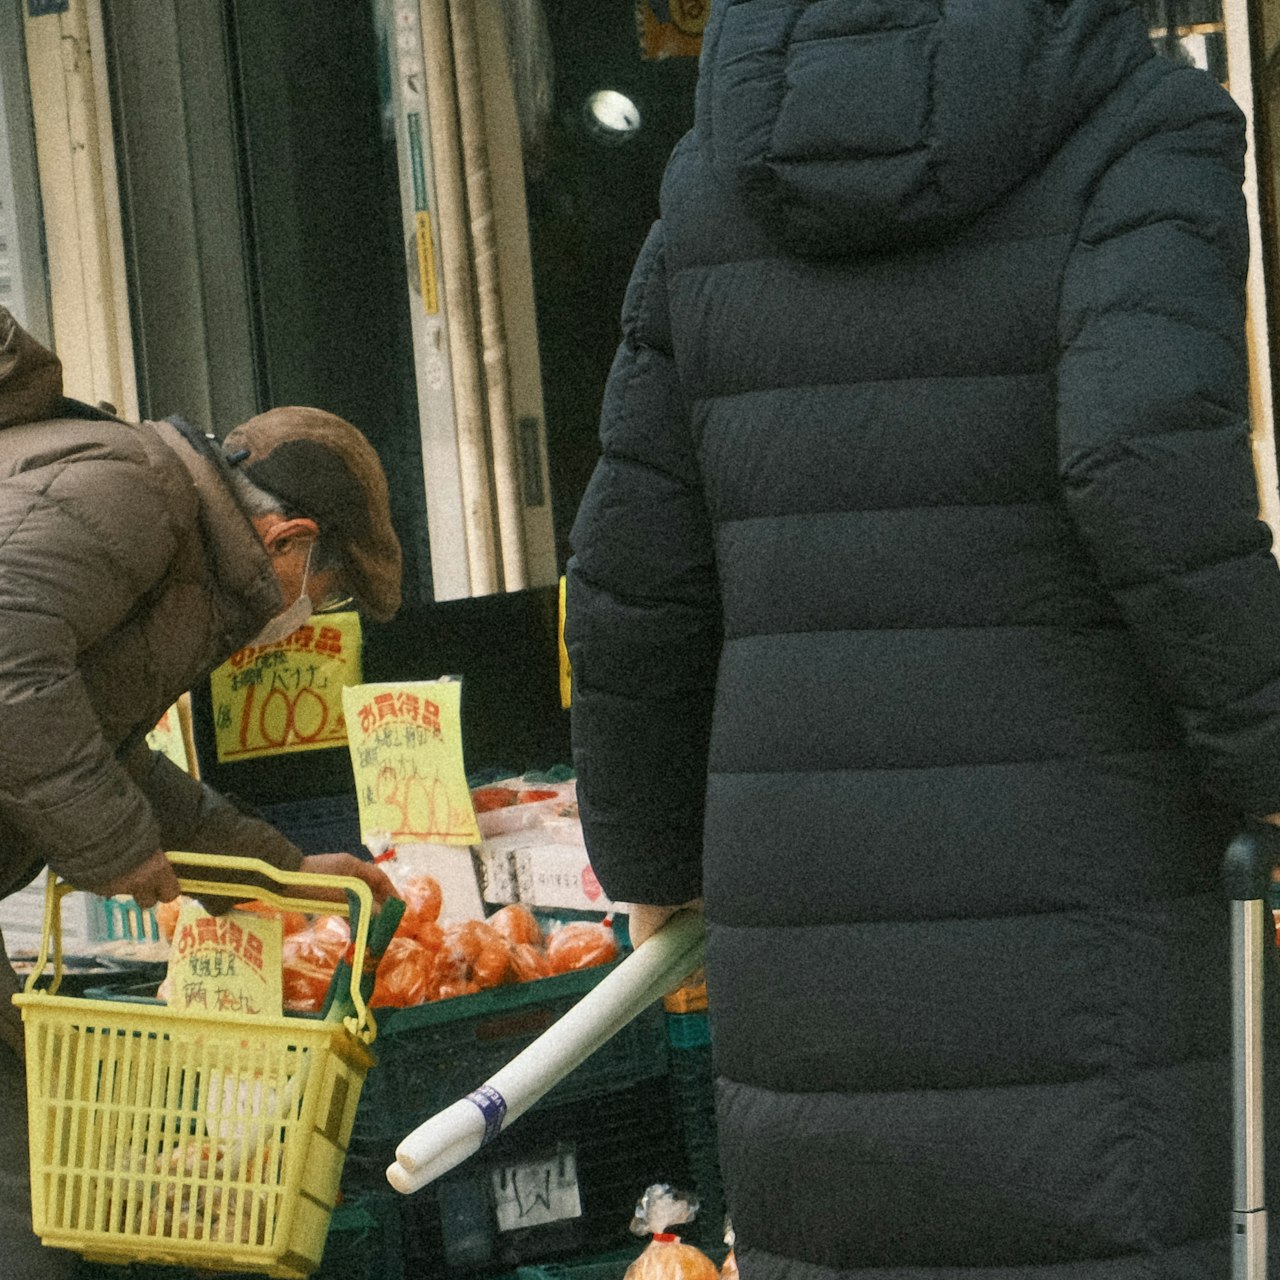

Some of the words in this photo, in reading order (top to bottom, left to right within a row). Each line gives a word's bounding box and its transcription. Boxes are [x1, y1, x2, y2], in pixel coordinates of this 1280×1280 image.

[239, 685, 329, 749] 100
[358, 692, 441, 734] お買得品
[178, 916, 264, 971] お買得品
